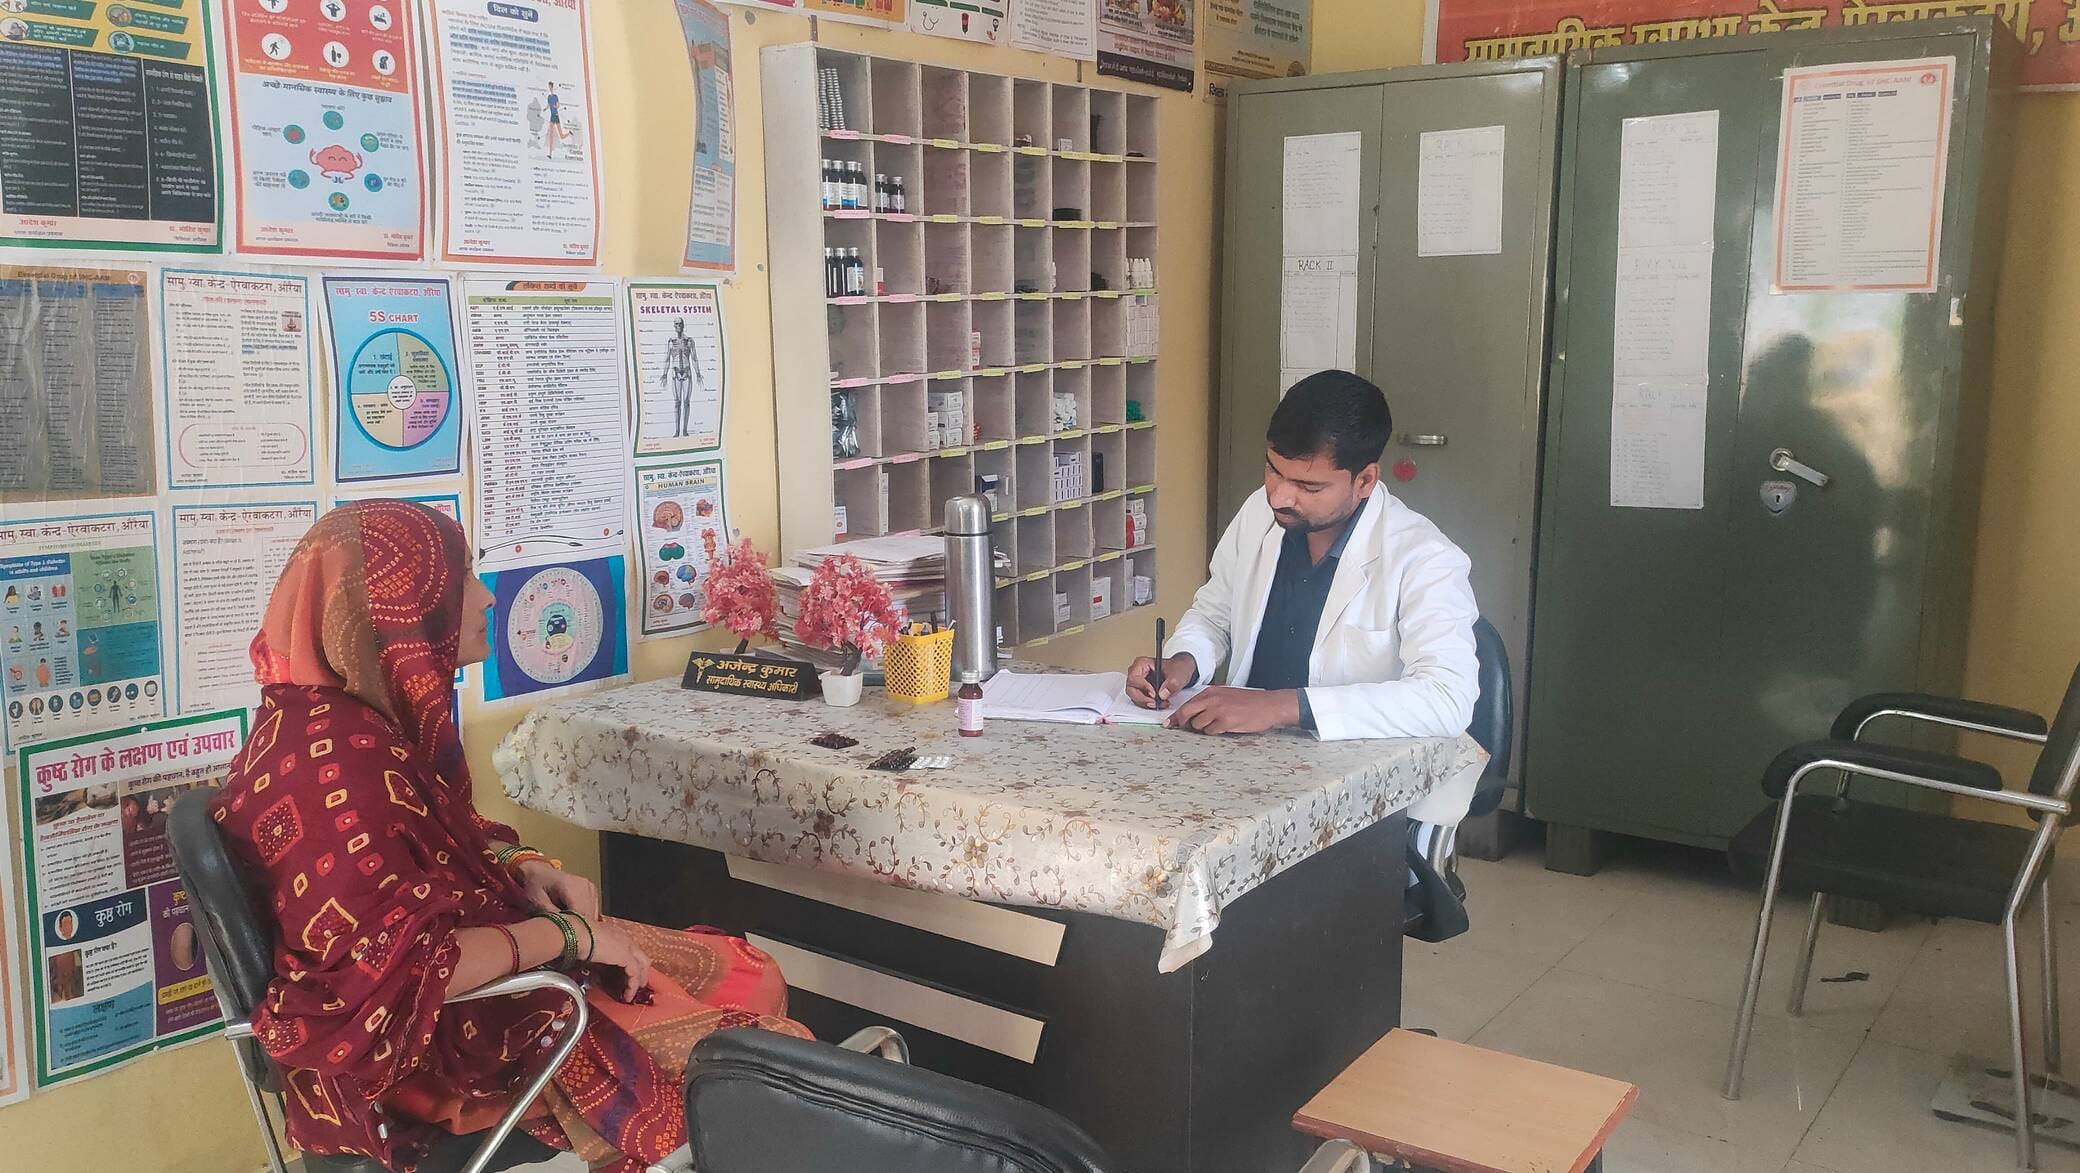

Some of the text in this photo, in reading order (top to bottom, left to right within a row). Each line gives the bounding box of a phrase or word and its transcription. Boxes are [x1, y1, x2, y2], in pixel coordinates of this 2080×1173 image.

[282, 82, 312, 94] मानसिक
[1298, 260, 1322, 272] RACK
[640, 306, 712, 314] SKELETAL SYSTEM
[370, 311, 386, 322] 5S
[658, 478, 705, 489] HUMAN BRAIN
[716, 658, 798, 680] अजेन्द्र कुमार
[706, 674, 799, 694] सामुदायिक स्वास्थ्य अधिकारी
[71, 752, 96, 779] रोग
[100, 746, 116, 774] के
[118, 741, 162, 770] लक्षण
[166, 732, 188, 760] एवं
[192, 730, 236, 756] उपचार
[95, 900, 132, 928] कुष्ठ रोग
